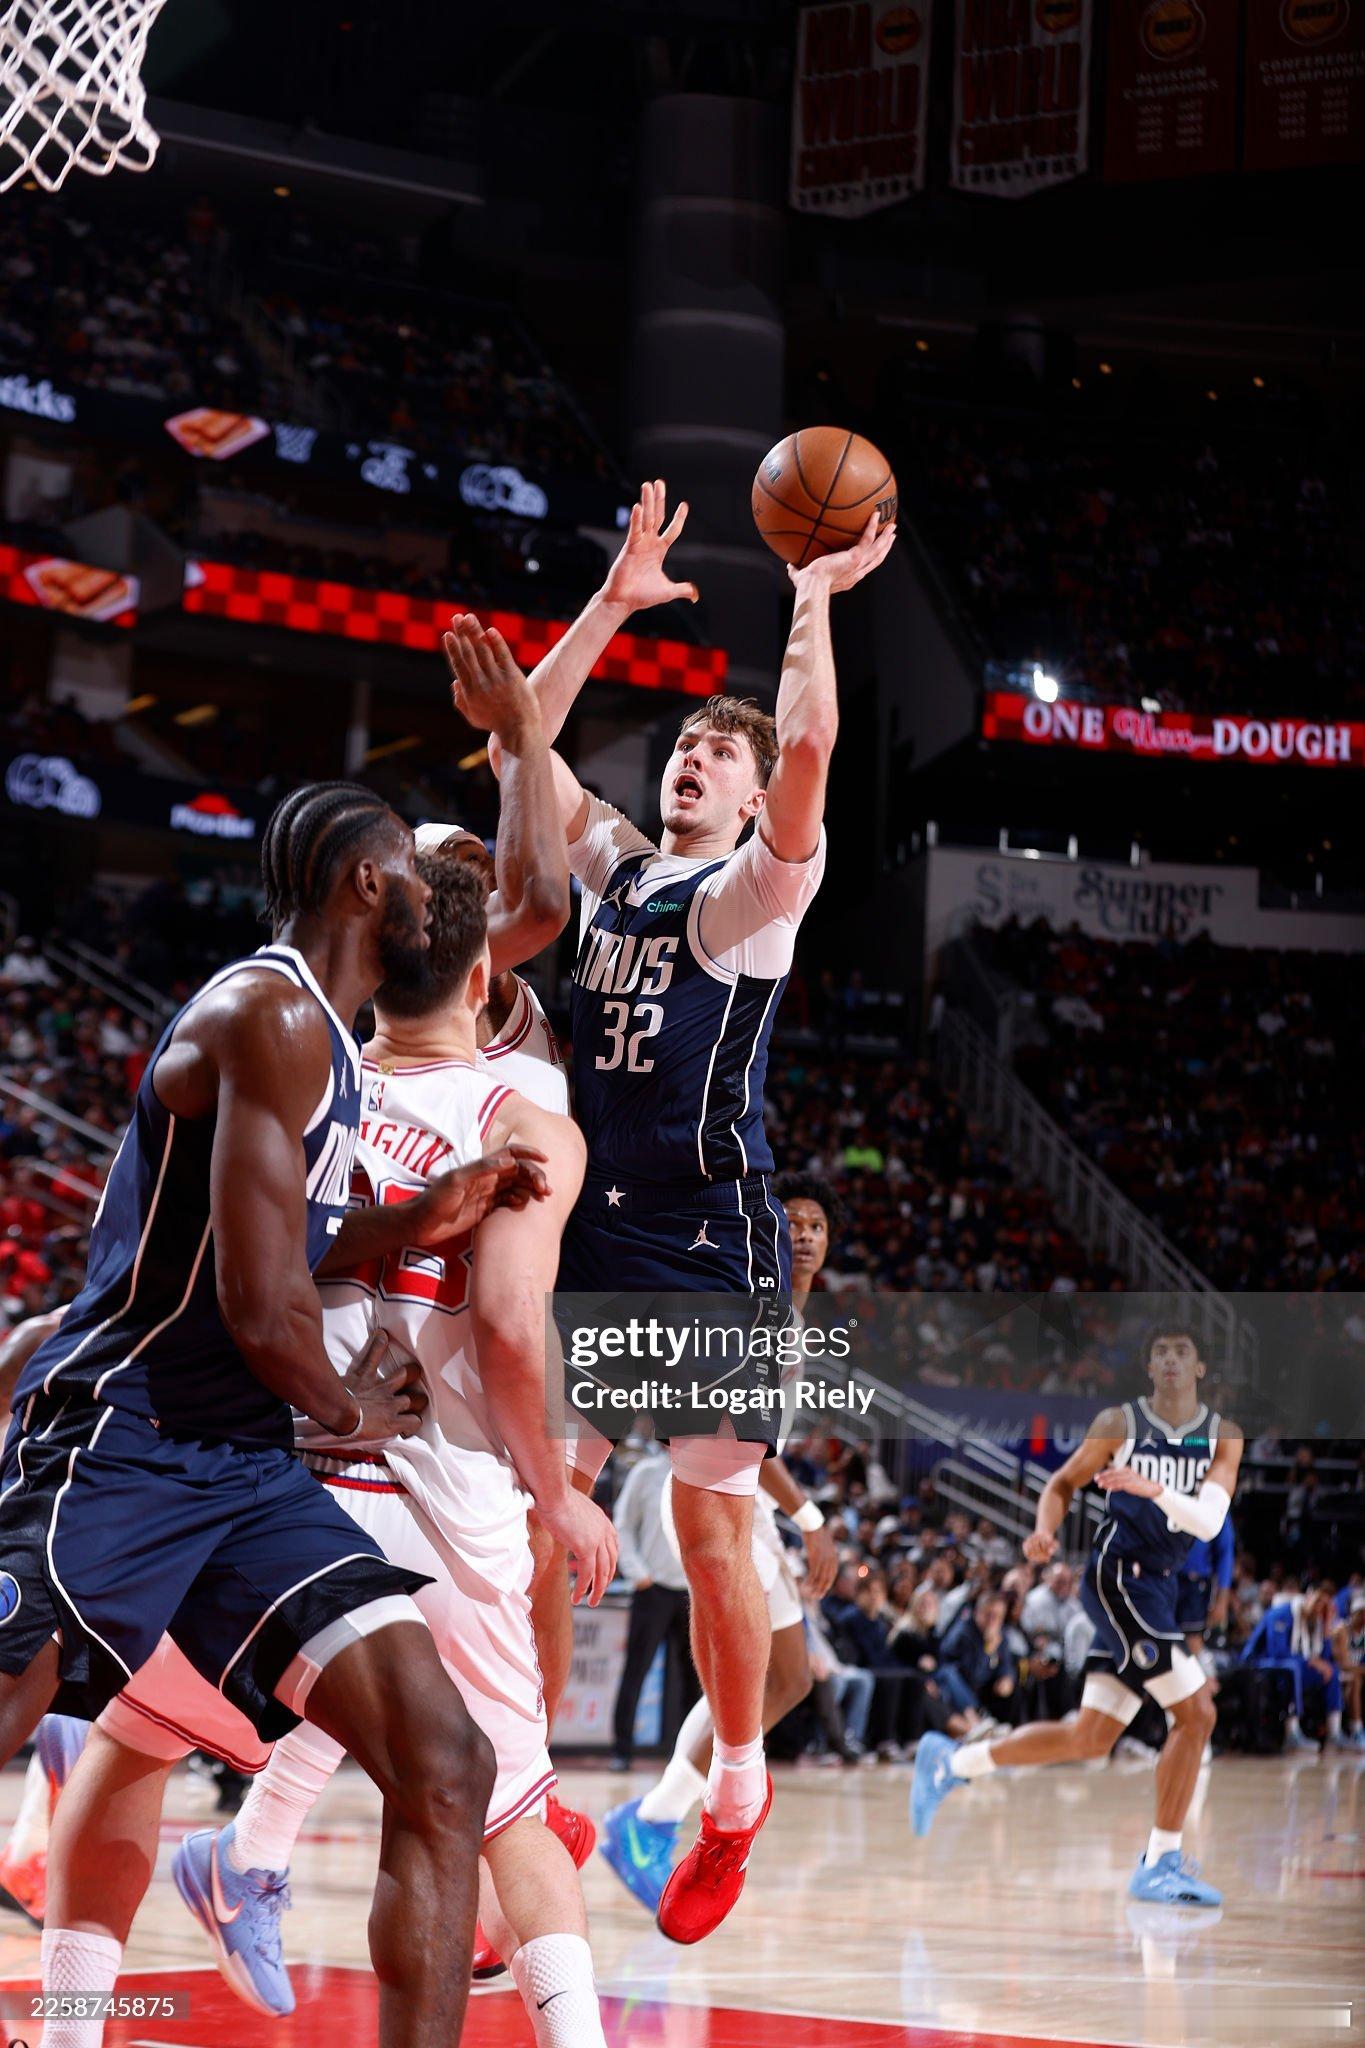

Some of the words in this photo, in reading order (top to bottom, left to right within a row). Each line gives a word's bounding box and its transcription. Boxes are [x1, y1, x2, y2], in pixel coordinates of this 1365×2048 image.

[1023, 702, 1104, 743] ONE
[1213, 718, 1351, 762] DOUGH
[595, 1001, 665, 1073] 32
